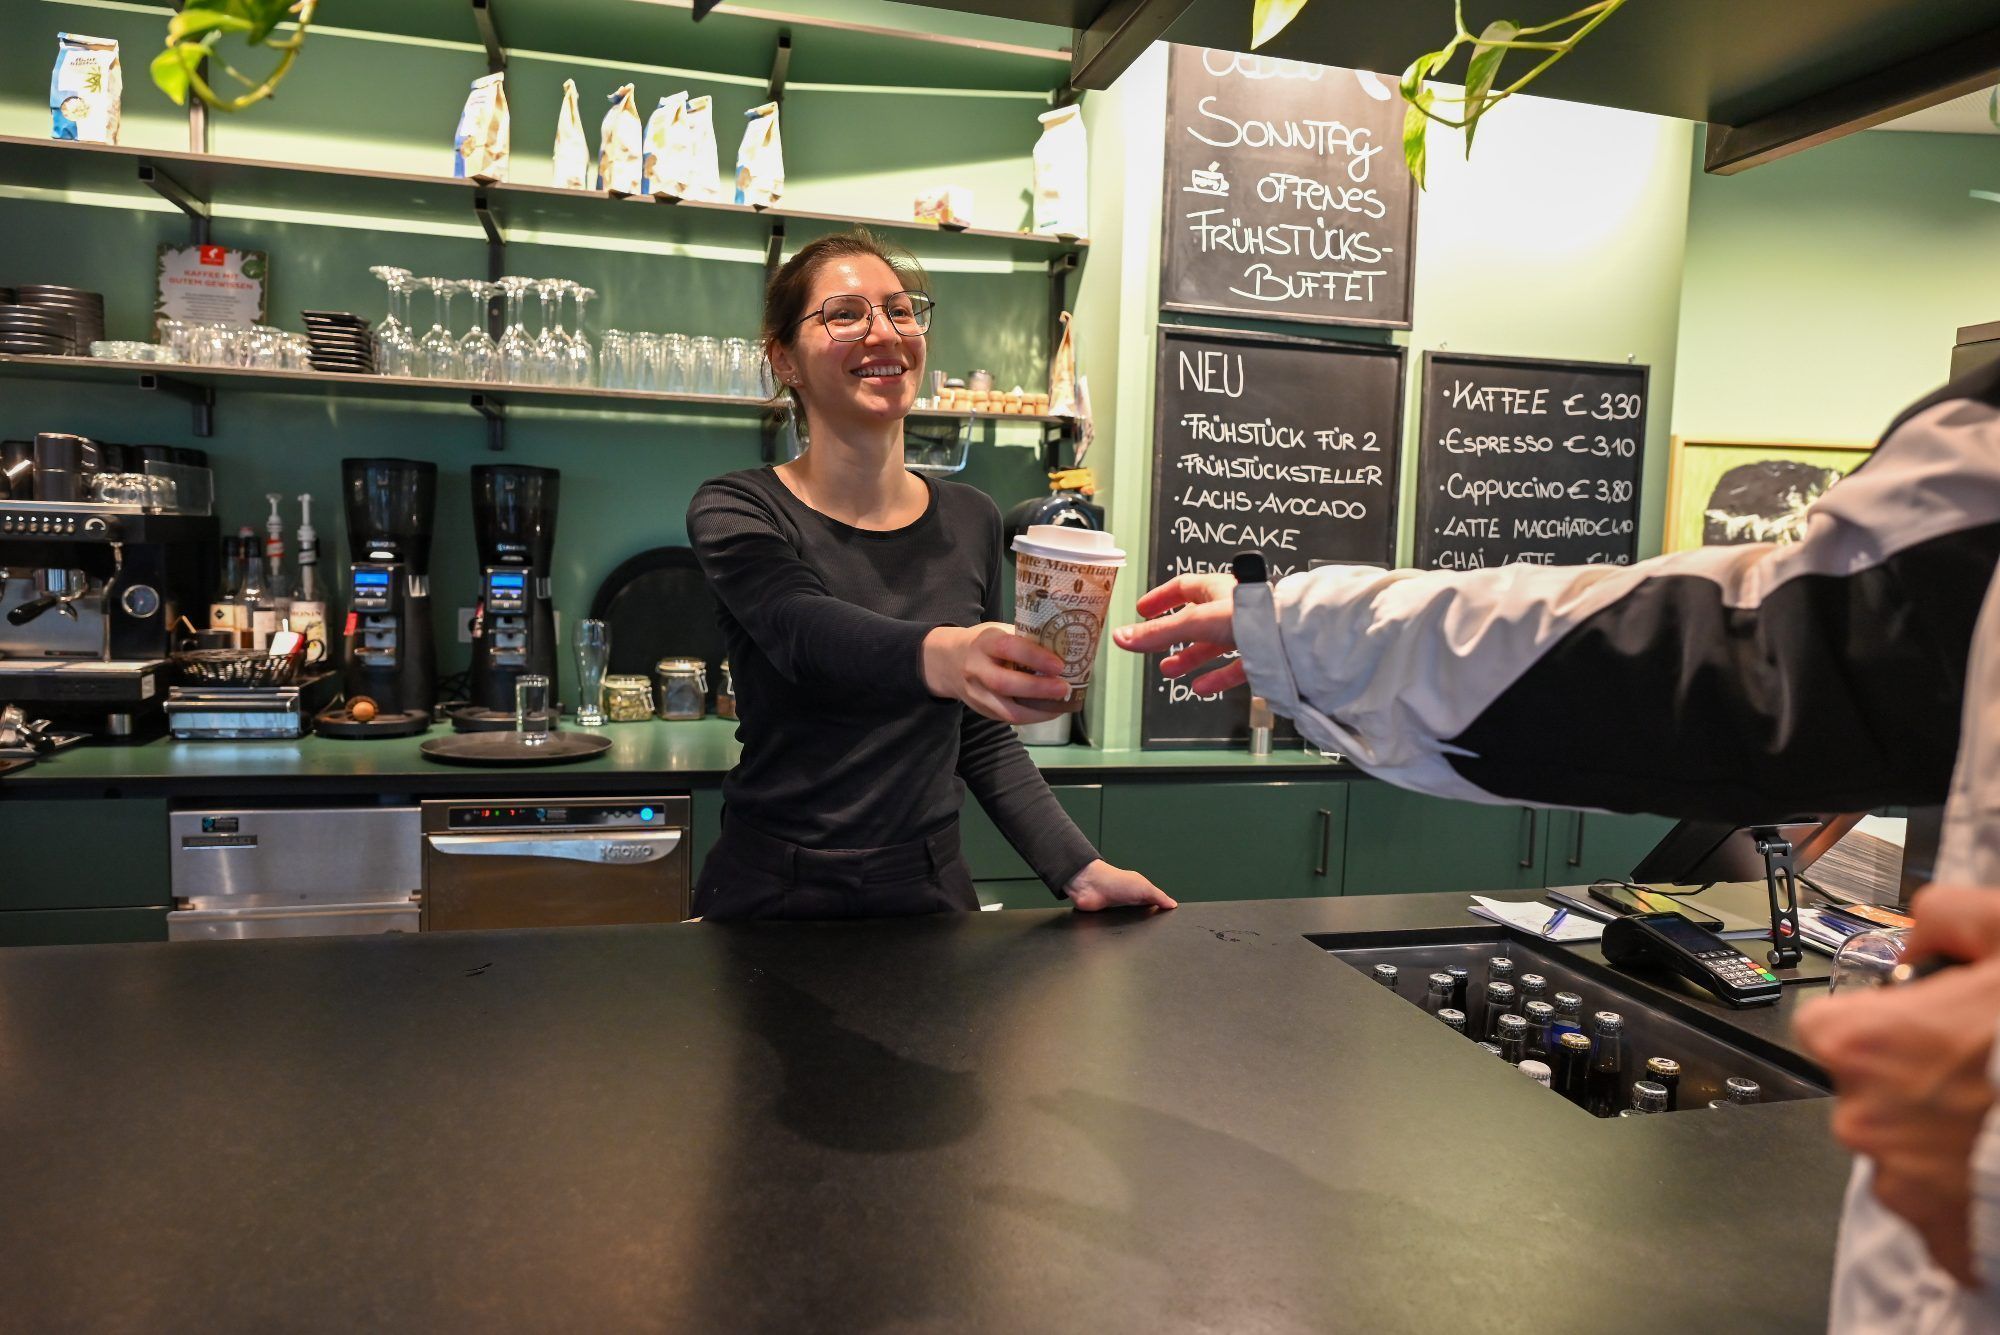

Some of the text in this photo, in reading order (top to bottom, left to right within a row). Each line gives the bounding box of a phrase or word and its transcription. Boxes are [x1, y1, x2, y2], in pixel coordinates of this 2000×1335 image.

[1186, 208, 1394, 264] FRÜHSTÜCKS-
[184, 270, 219, 279] KAFFEE
[1229, 263, 1387, 302] BUFFET
[1179, 350, 1244, 398] NEU
[1452, 380, 1550, 415] KAFFEE
[1591, 393, 1642, 421] 3,30
[1184, 413, 1381, 452] FRÜHSTÜCK FÜR 2
[1446, 427, 1554, 457] ESPRESSO
[1590, 435, 1636, 458] 3,10
[1181, 453, 1383, 486] FRÜHSTÜCKSTELLER
[1594, 479, 1633, 504] 3,80
[1175, 516, 1301, 551] PANCAKE
[1442, 516, 1501, 538] LATTE
